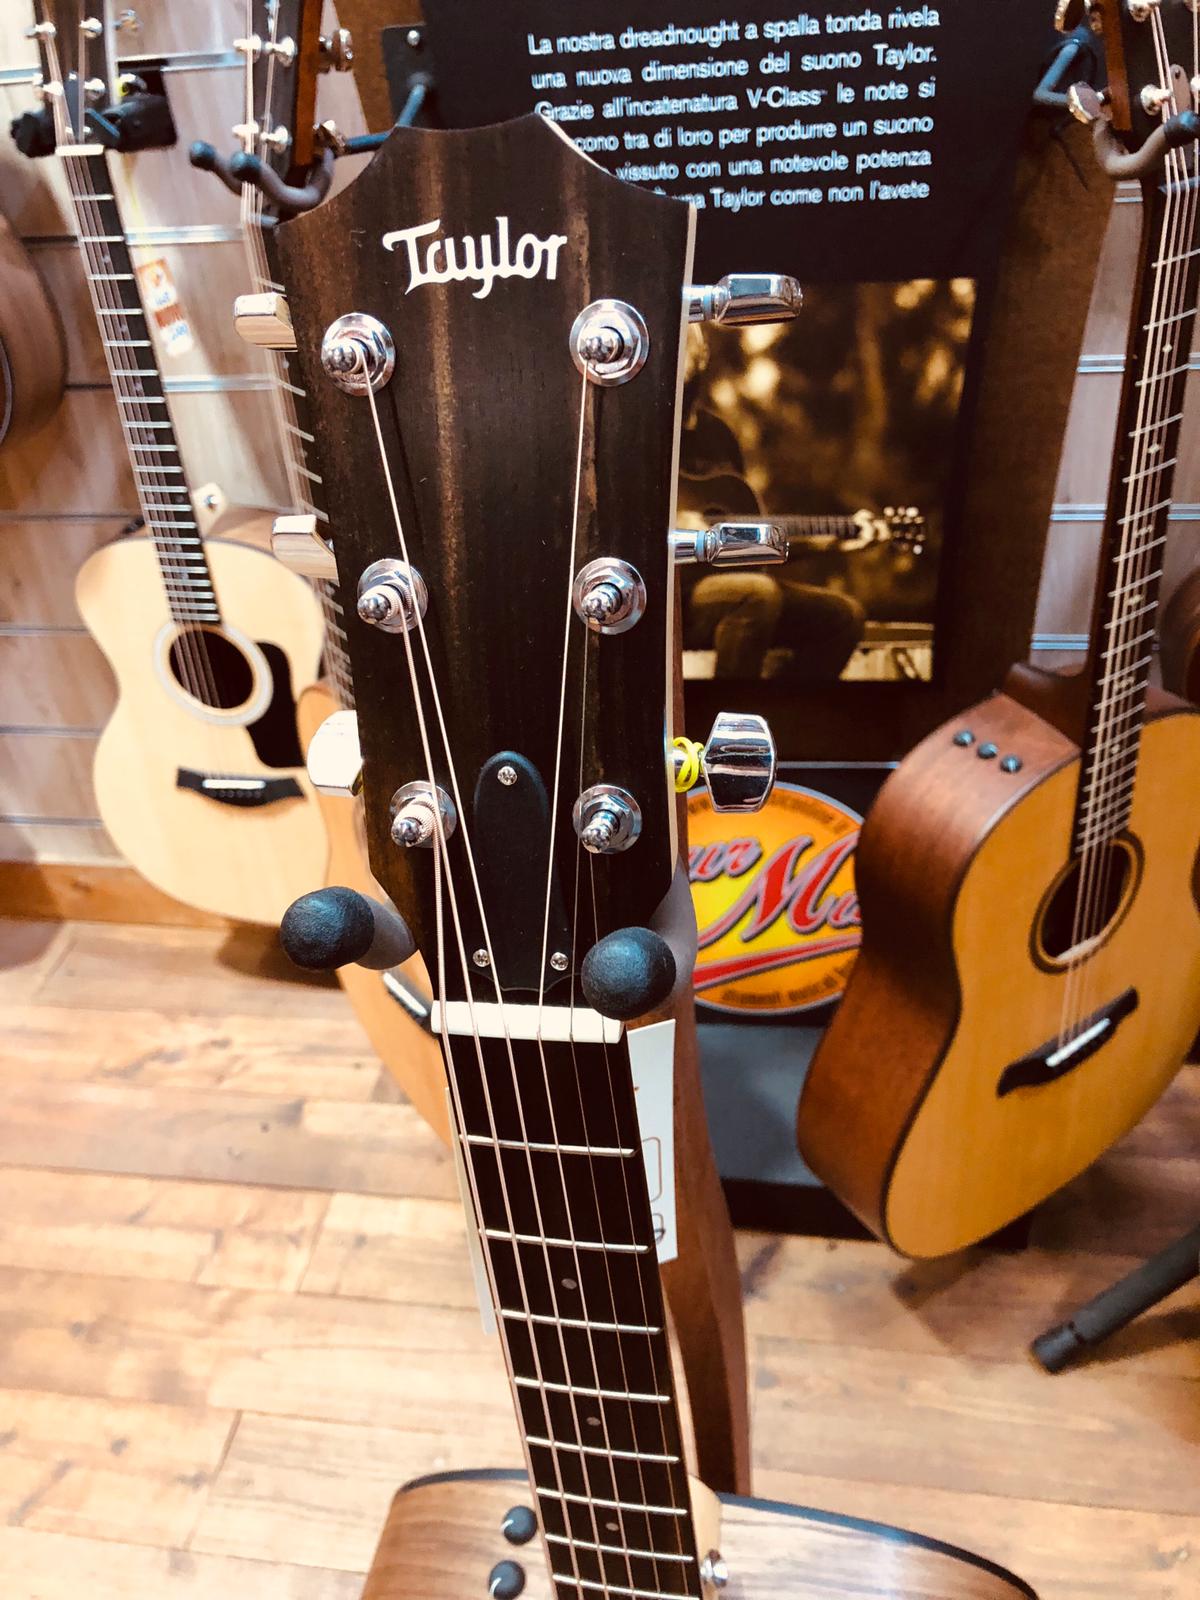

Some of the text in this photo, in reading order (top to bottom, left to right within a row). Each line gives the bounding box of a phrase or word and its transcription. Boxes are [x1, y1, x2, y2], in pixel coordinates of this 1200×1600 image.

[528, 5, 939, 56] La nostra dreadnought a spalla tonda rivela
[532, 42, 937, 89] una nuova dimensione del suono Taylor.
[535, 100, 594, 121] Grazie
[836, 83, 855, 104] le
[864, 80, 908, 102] note
[918, 75, 936, 98] si
[624, 132, 649, 150] tra
[654, 126, 672, 148] di
[678, 126, 713, 147] loro
[719, 127, 750, 149] per
[756, 121, 837, 147] produrre
[843, 119, 867, 137] un
[873, 115, 934, 135] suono
[616, 148, 932, 182] vissuto con una notevole potenza
[709, 186, 766, 212] Taylor
[770, 186, 823, 206] come
[828, 184, 864, 202] non
[382, 216, 567, 299] Taylor
